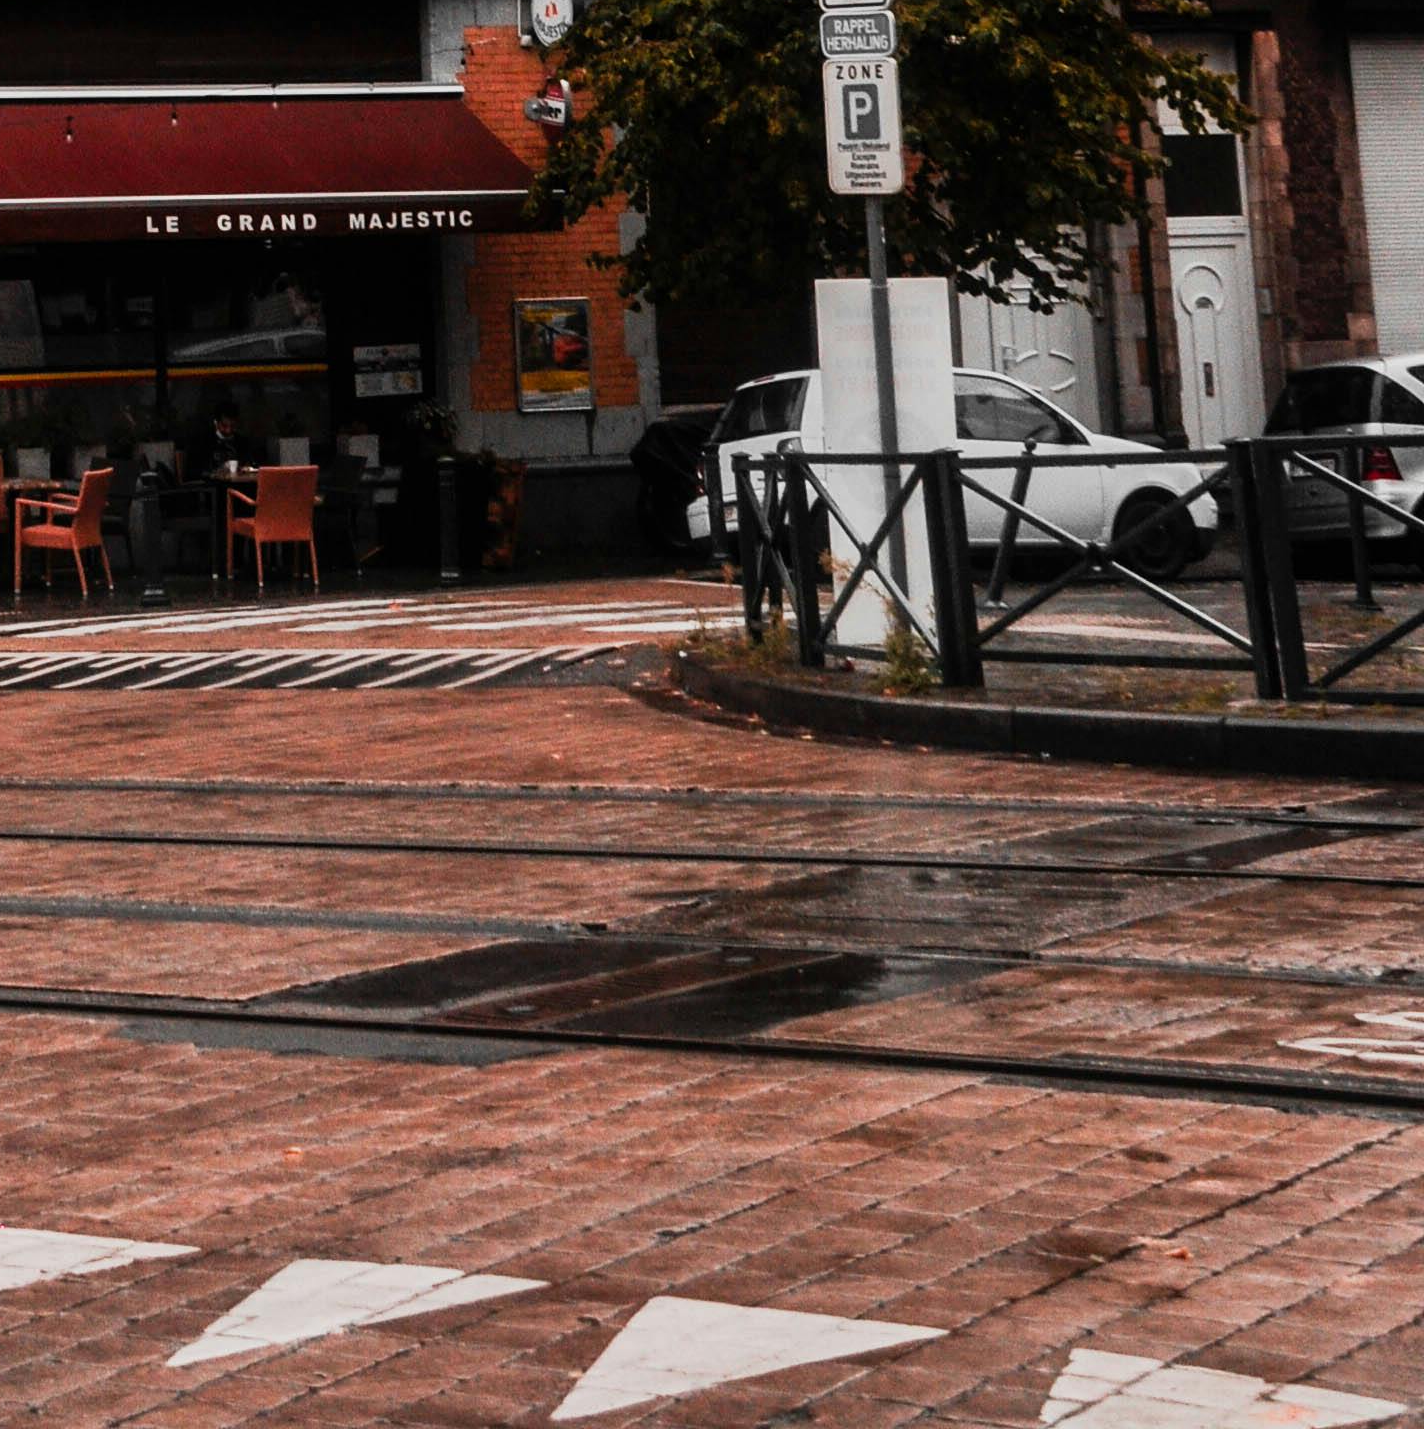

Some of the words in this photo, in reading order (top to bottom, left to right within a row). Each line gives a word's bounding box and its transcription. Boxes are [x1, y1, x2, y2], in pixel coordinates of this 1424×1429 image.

[834, 18, 879, 34] RAPPEL
[826, 36, 889, 51] HERHALING
[836, 64, 884, 80] ZONE
[848, 90, 873, 134] P
[146, 216, 179, 232] LE
[217, 213, 317, 231] GRAND
[349, 210, 473, 229] MAJESTIC
